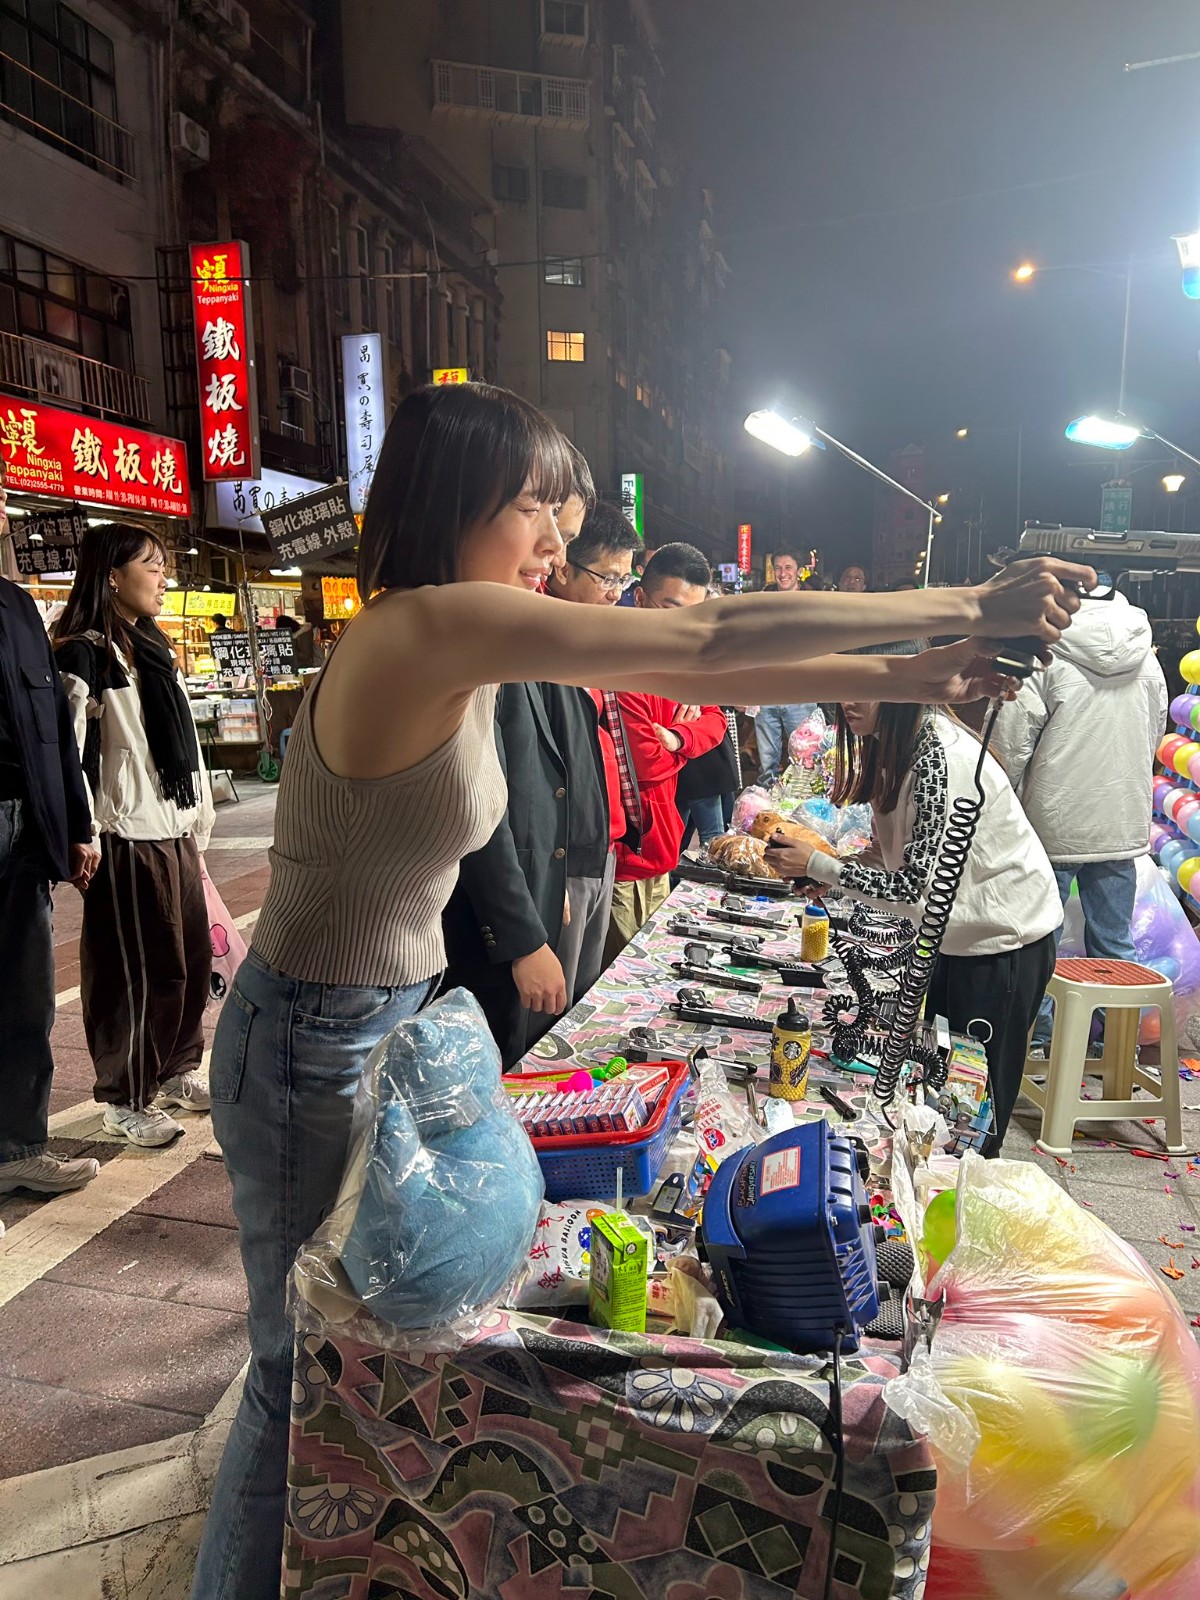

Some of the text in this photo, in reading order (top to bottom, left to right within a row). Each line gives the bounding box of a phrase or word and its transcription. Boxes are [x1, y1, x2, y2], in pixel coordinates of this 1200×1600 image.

[197, 292, 239, 305] Teppanyaki
[209, 283, 239, 294] Ningxia
[201, 316, 246, 466] 鐵板燒
[5, 461, 63, 481] Teppanyaki
[27, 453, 62, 471] Ningxia
[71, 427, 182, 493] 鐵板燒
[268, 496, 347, 538] 鋼化玻璃貼
[277, 520, 355, 561] 充電線 外殼
[561, 1209, 582, 1244] BALLOON
